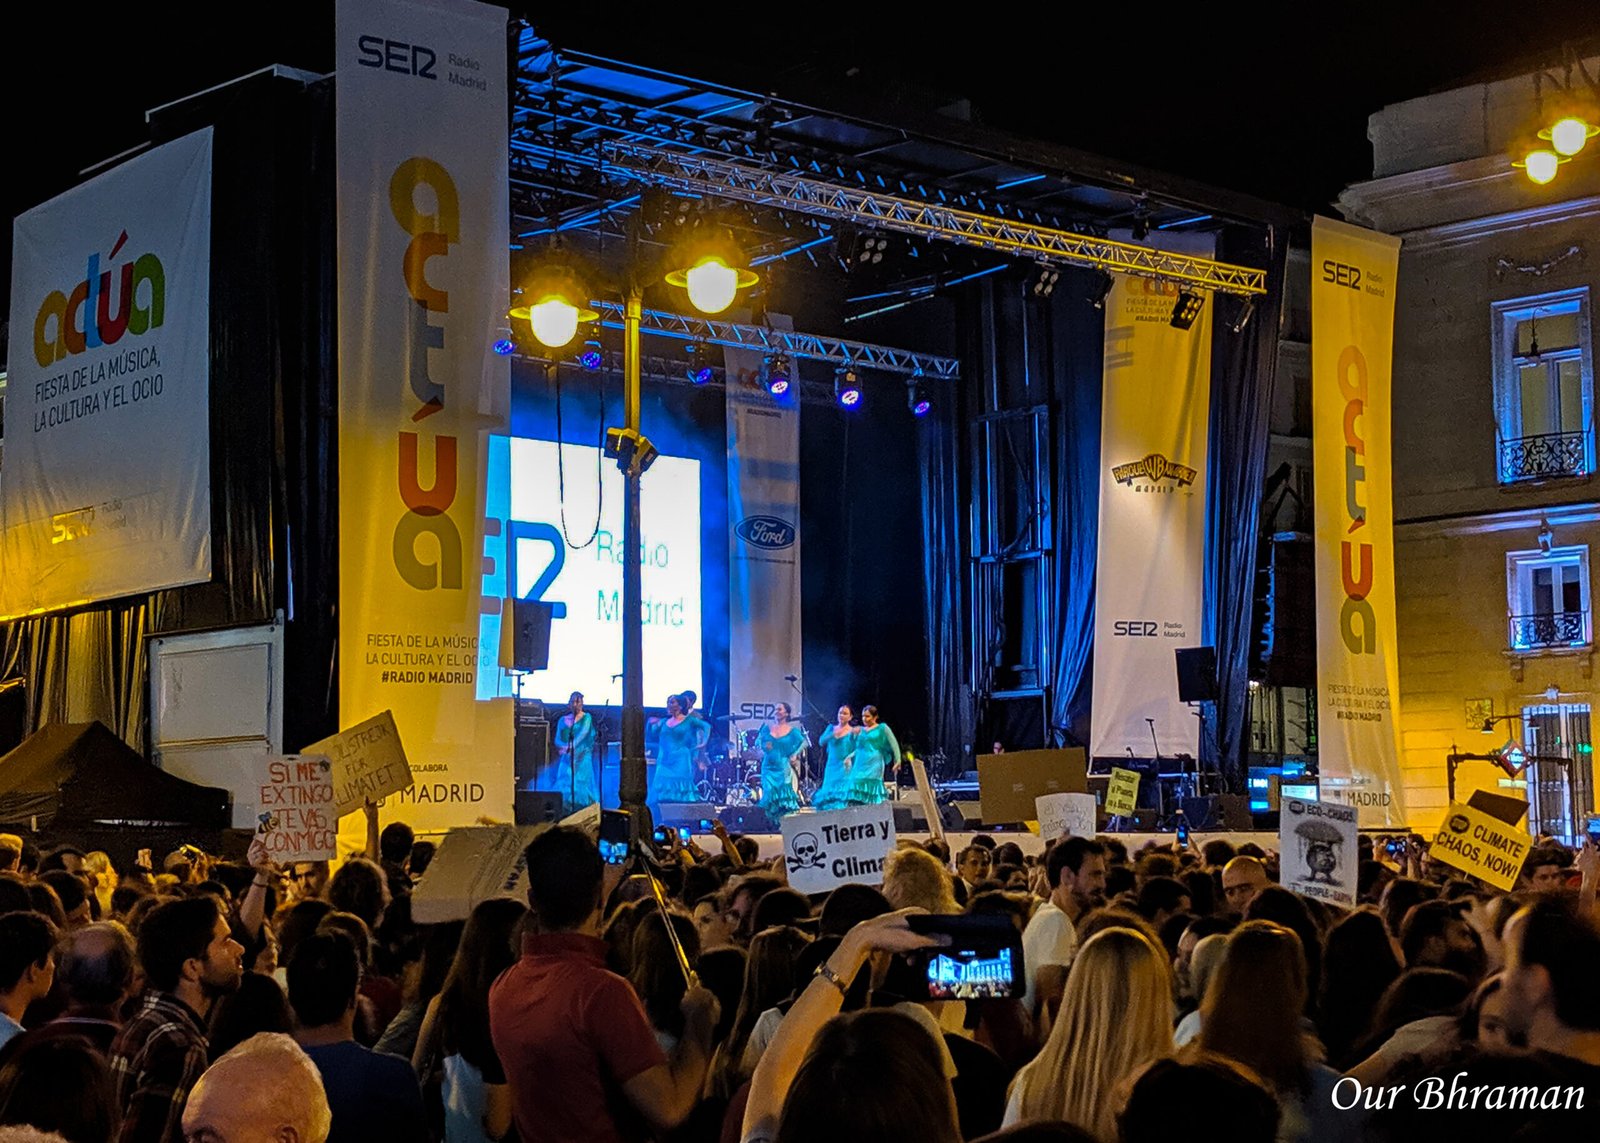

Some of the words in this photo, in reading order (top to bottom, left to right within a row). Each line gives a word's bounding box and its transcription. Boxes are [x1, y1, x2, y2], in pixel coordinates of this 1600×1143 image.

[358, 35, 437, 80] SER
[449, 53, 480, 71] Radio
[448, 72, 487, 91] Madrid
[1322, 260, 1361, 291] SER
[33, 229, 166, 368] actúa
[1365, 284, 1385, 298] Madrid
[35, 373, 70, 404] FIESTA
[72, 366, 88, 391] DE
[91, 362, 106, 385] LA
[34, 410, 47, 433] LA
[48, 392, 100, 427] CULTURA
[103, 388, 111, 411] Y
[113, 385, 128, 408] EL
[132, 373, 164, 402] OCIO
[750, 520, 786, 544] Ford
[598, 590, 684, 626] Mdrid
[1113, 621, 1158, 636] SER
[367, 634, 403, 647] FIESTA
[407, 635, 422, 648] DE
[425, 636, 439, 648] LA
[366, 652, 379, 665] LA
[381, 653, 435, 666] CULTURA
[436, 654, 445, 666] Y
[447, 655, 461, 666] EL
[381, 671, 425, 683] #RADIO
[429, 671, 473, 683] MADRID
[741, 703, 776, 720] SER
[269, 762, 291, 783] SI
[296, 762, 321, 782] ME
[261, 784, 334, 805] EXTINGO
[401, 783, 484, 804] MADRID
[1347, 791, 1391, 807] MADRID
[273, 808, 297, 829] TE
[298, 808, 327, 829] VAS
[264, 829, 337, 852] CONMIGO
[822, 822, 875, 844] Tierra
[879, 820, 889, 840] y
[1473, 825, 1524, 858] CLIMATE
[1437, 832, 1480, 866] CHAOS,
[1484, 853, 1518, 880] NOW!
